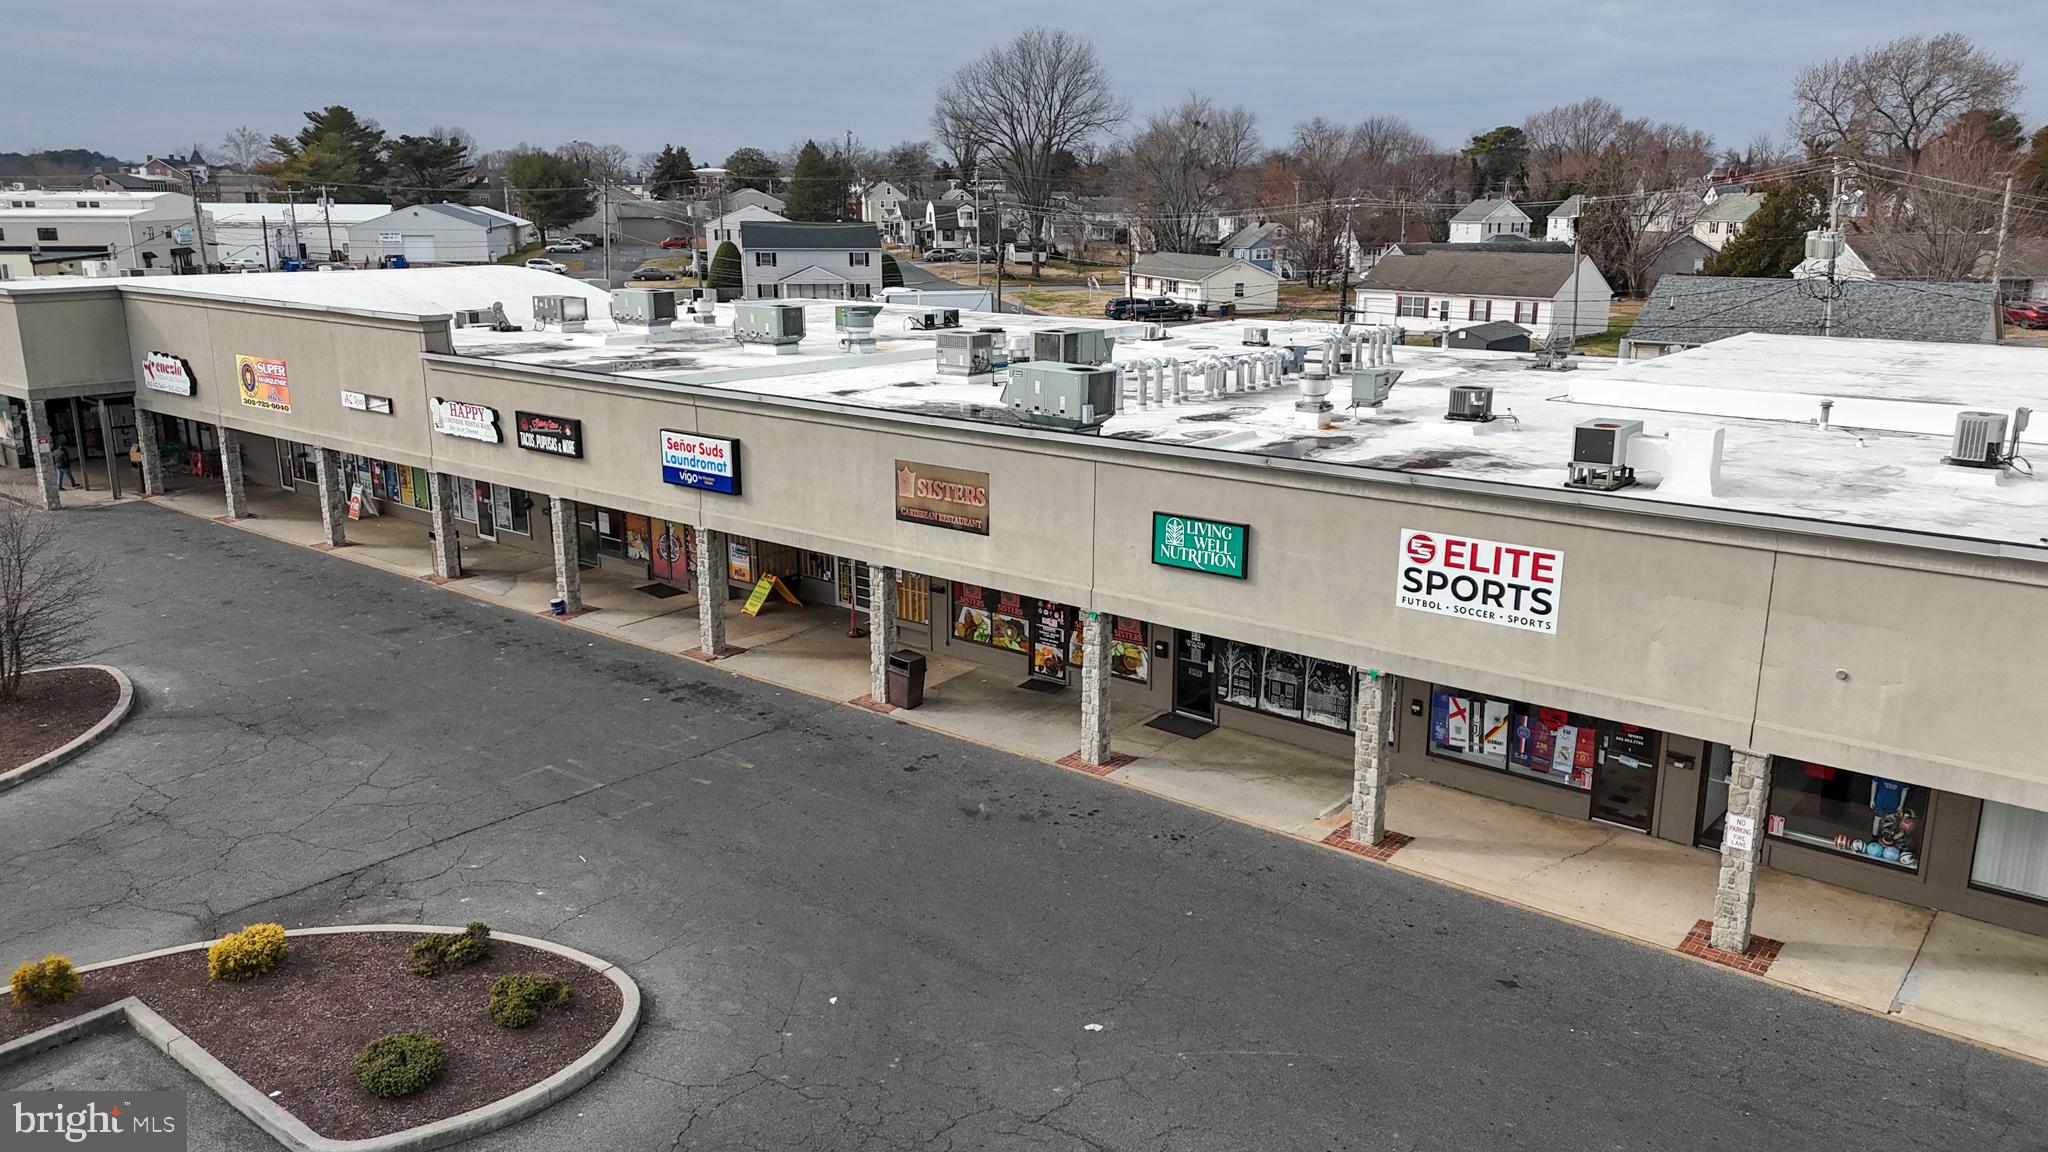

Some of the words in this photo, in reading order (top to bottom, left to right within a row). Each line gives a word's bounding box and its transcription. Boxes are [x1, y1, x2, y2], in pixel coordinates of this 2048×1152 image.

[257, 361, 286, 376] SUPER
[449, 403, 484, 421] HAPPY
[562, 439, 576, 455] MORE
[666, 437, 696, 453] Señor
[698, 442, 724, 459] Suds
[665, 451, 727, 473] Laundromat
[679, 470, 698, 484] vigo
[917, 479, 986, 507] SISTERS
[938, 513, 982, 529] RESTAURANT
[1187, 520, 1232, 540] LIVING
[1194, 536, 1232, 555] WELL
[1160, 543, 1237, 570] NUTRITION
[1444, 539, 1556, 583] ELITE
[1402, 567, 1553, 615] SPORTS
[1402, 596, 1442, 610] FUTBOL
[1454, 605, 1495, 620] SOCCER
[1507, 614, 1551, 630] SPORTS
[1114, 629, 1143, 642] SISTERS
[1730, 825, 1752, 835] PARKING
[1731, 840, 1746, 848] LANE
